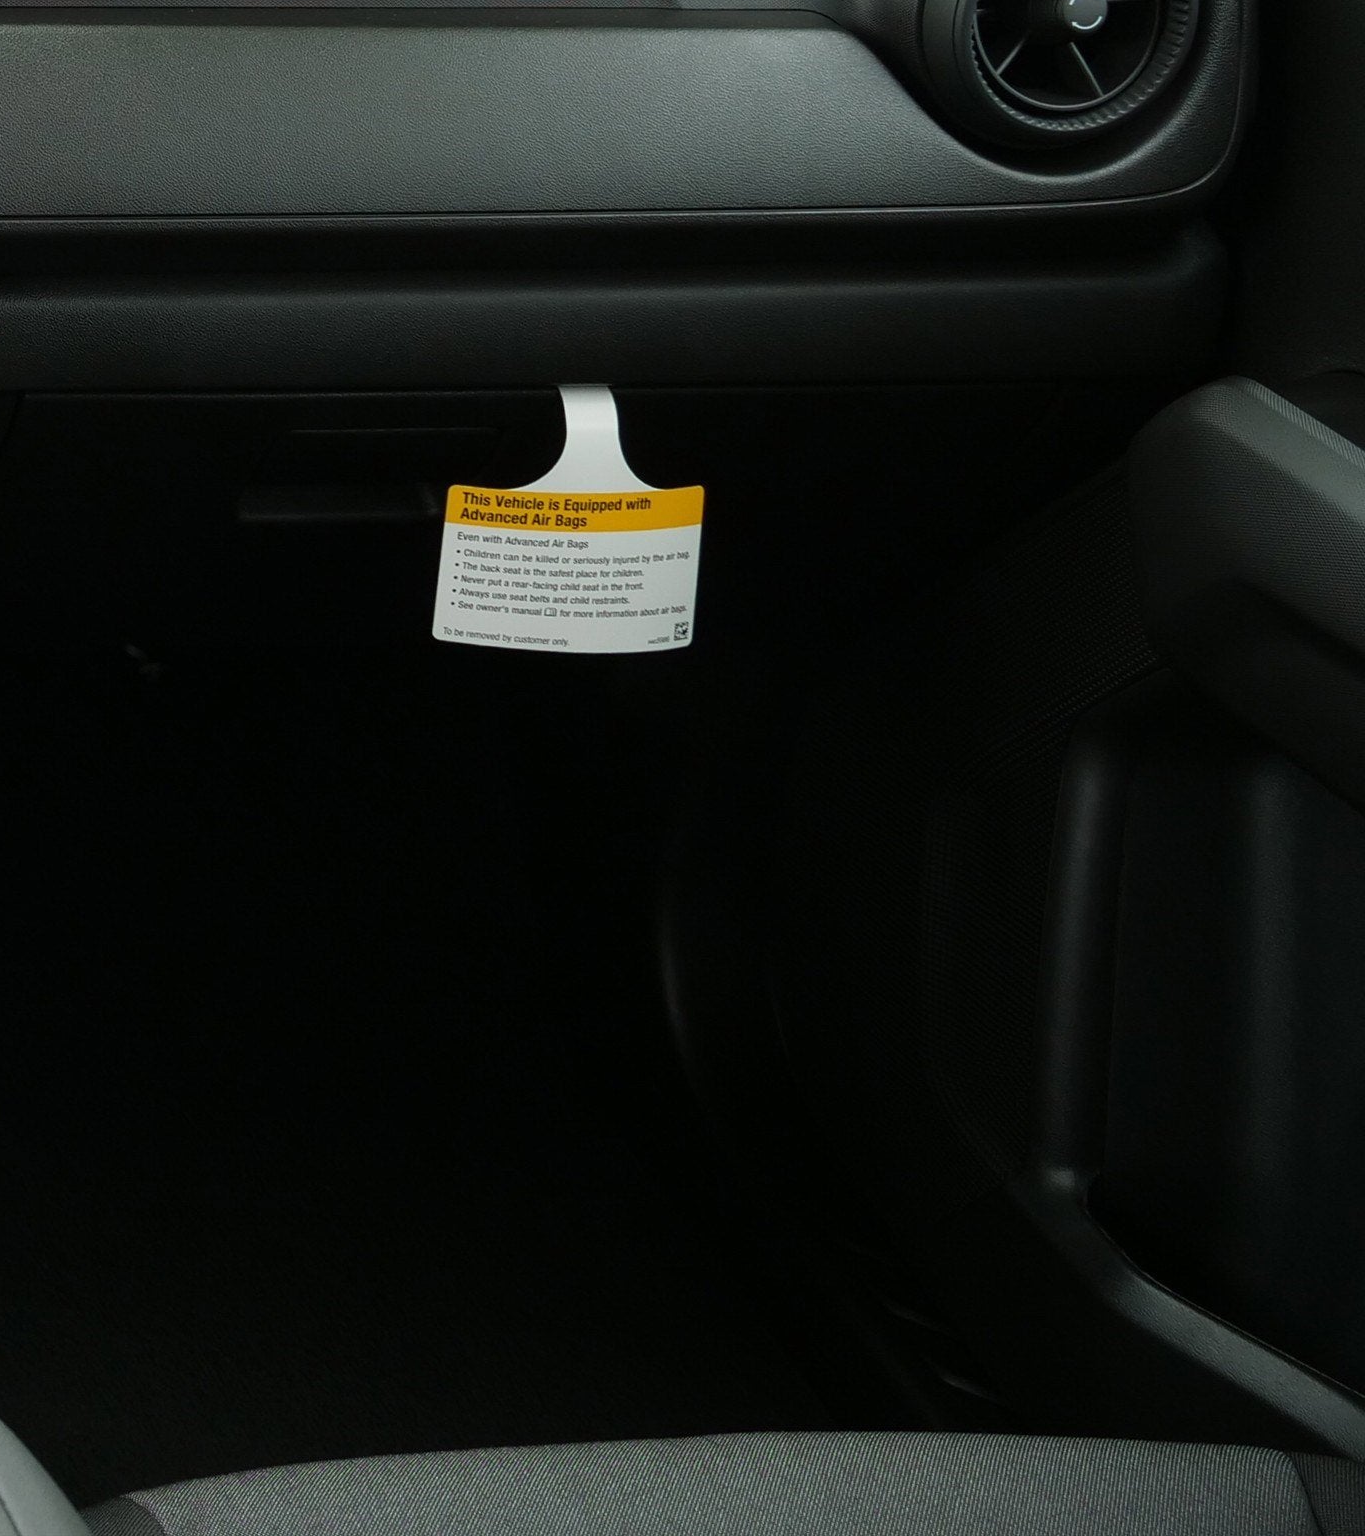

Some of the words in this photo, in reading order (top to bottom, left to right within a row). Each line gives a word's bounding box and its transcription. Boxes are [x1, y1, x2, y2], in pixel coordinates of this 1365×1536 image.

[463, 492, 490, 506] This
[495, 495, 544, 510] Vehicle
[549, 499, 559, 510] is
[564, 499, 622, 513] Equipped
[626, 497, 651, 510] with
[460, 508, 528, 525] Advanced
[532, 514, 551, 526] Air
[555, 514, 587, 529] Bags
[457, 532, 479, 541] Even
[482, 535, 502, 544] with
[504, 537, 549, 547] Advanced
[551, 539, 564, 548] Air
[567, 540, 589, 550] Bags
[464, 548, 501, 560] Children
[503, 553, 519, 561] can
[522, 554, 532, 562] be
[535, 555, 559, 563] killed
[573, 556, 610, 565] seriously
[612, 555, 640, 565] injured
[642, 555, 650, 564] by
[653, 554, 664, 562] the
[462, 562, 478, 571] The
[480, 564, 500, 573] back
[503, 566, 521, 575] seat
[533, 569, 546, 577] the
[549, 569, 574, 577] safest
[576, 570, 597, 578] place
[460, 575, 486, 584] Never
[511, 582, 558, 592] rear-facing
[560, 583, 580, 591] child
[459, 588, 489, 599] Always
[509, 594, 527, 602] seat
[529, 595, 550, 603] belts
[458, 601, 474, 609] See
[511, 607, 542, 615] manual
[596, 609, 638, 618] information
[639, 608, 659, 617] about
[443, 627, 452, 635] To
[454, 628, 464, 637] be
[466, 630, 500, 641] removed
[514, 636, 550, 645] customer
